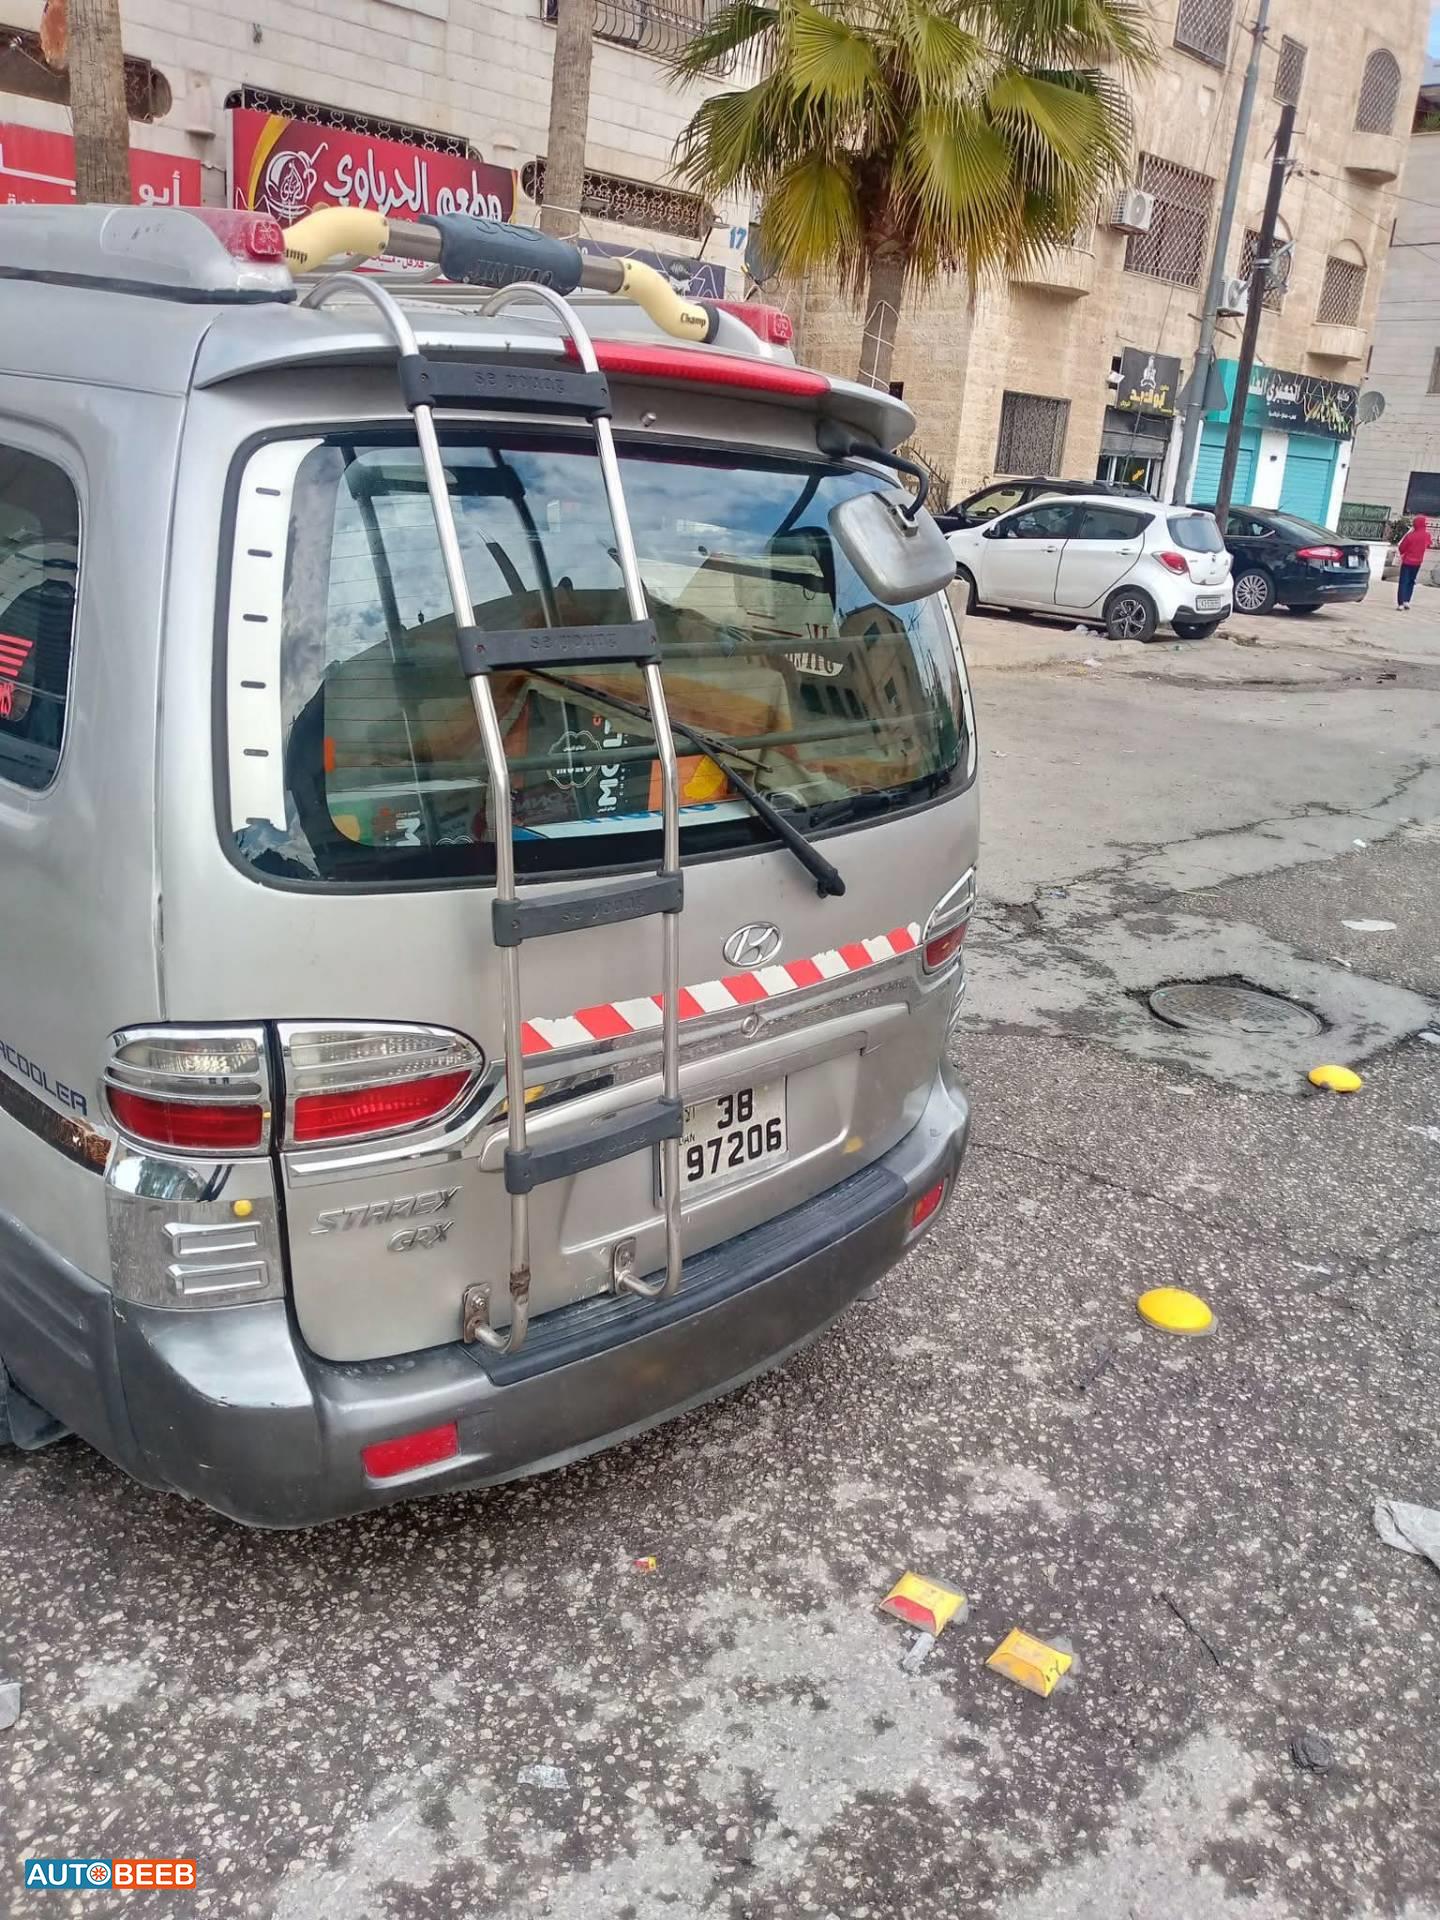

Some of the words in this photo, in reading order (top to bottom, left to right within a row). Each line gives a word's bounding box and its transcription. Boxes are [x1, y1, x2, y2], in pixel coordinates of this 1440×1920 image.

[436, 169, 503, 223] مطعم
[729, 226, 747, 250] 17
[680, 312, 706, 327] Champ
[717, 1088, 753, 1130] 38
[686, 1117, 782, 1182] 97206
[309, 1184, 464, 1235] STAREX
[386, 1219, 455, 1252] GRX
